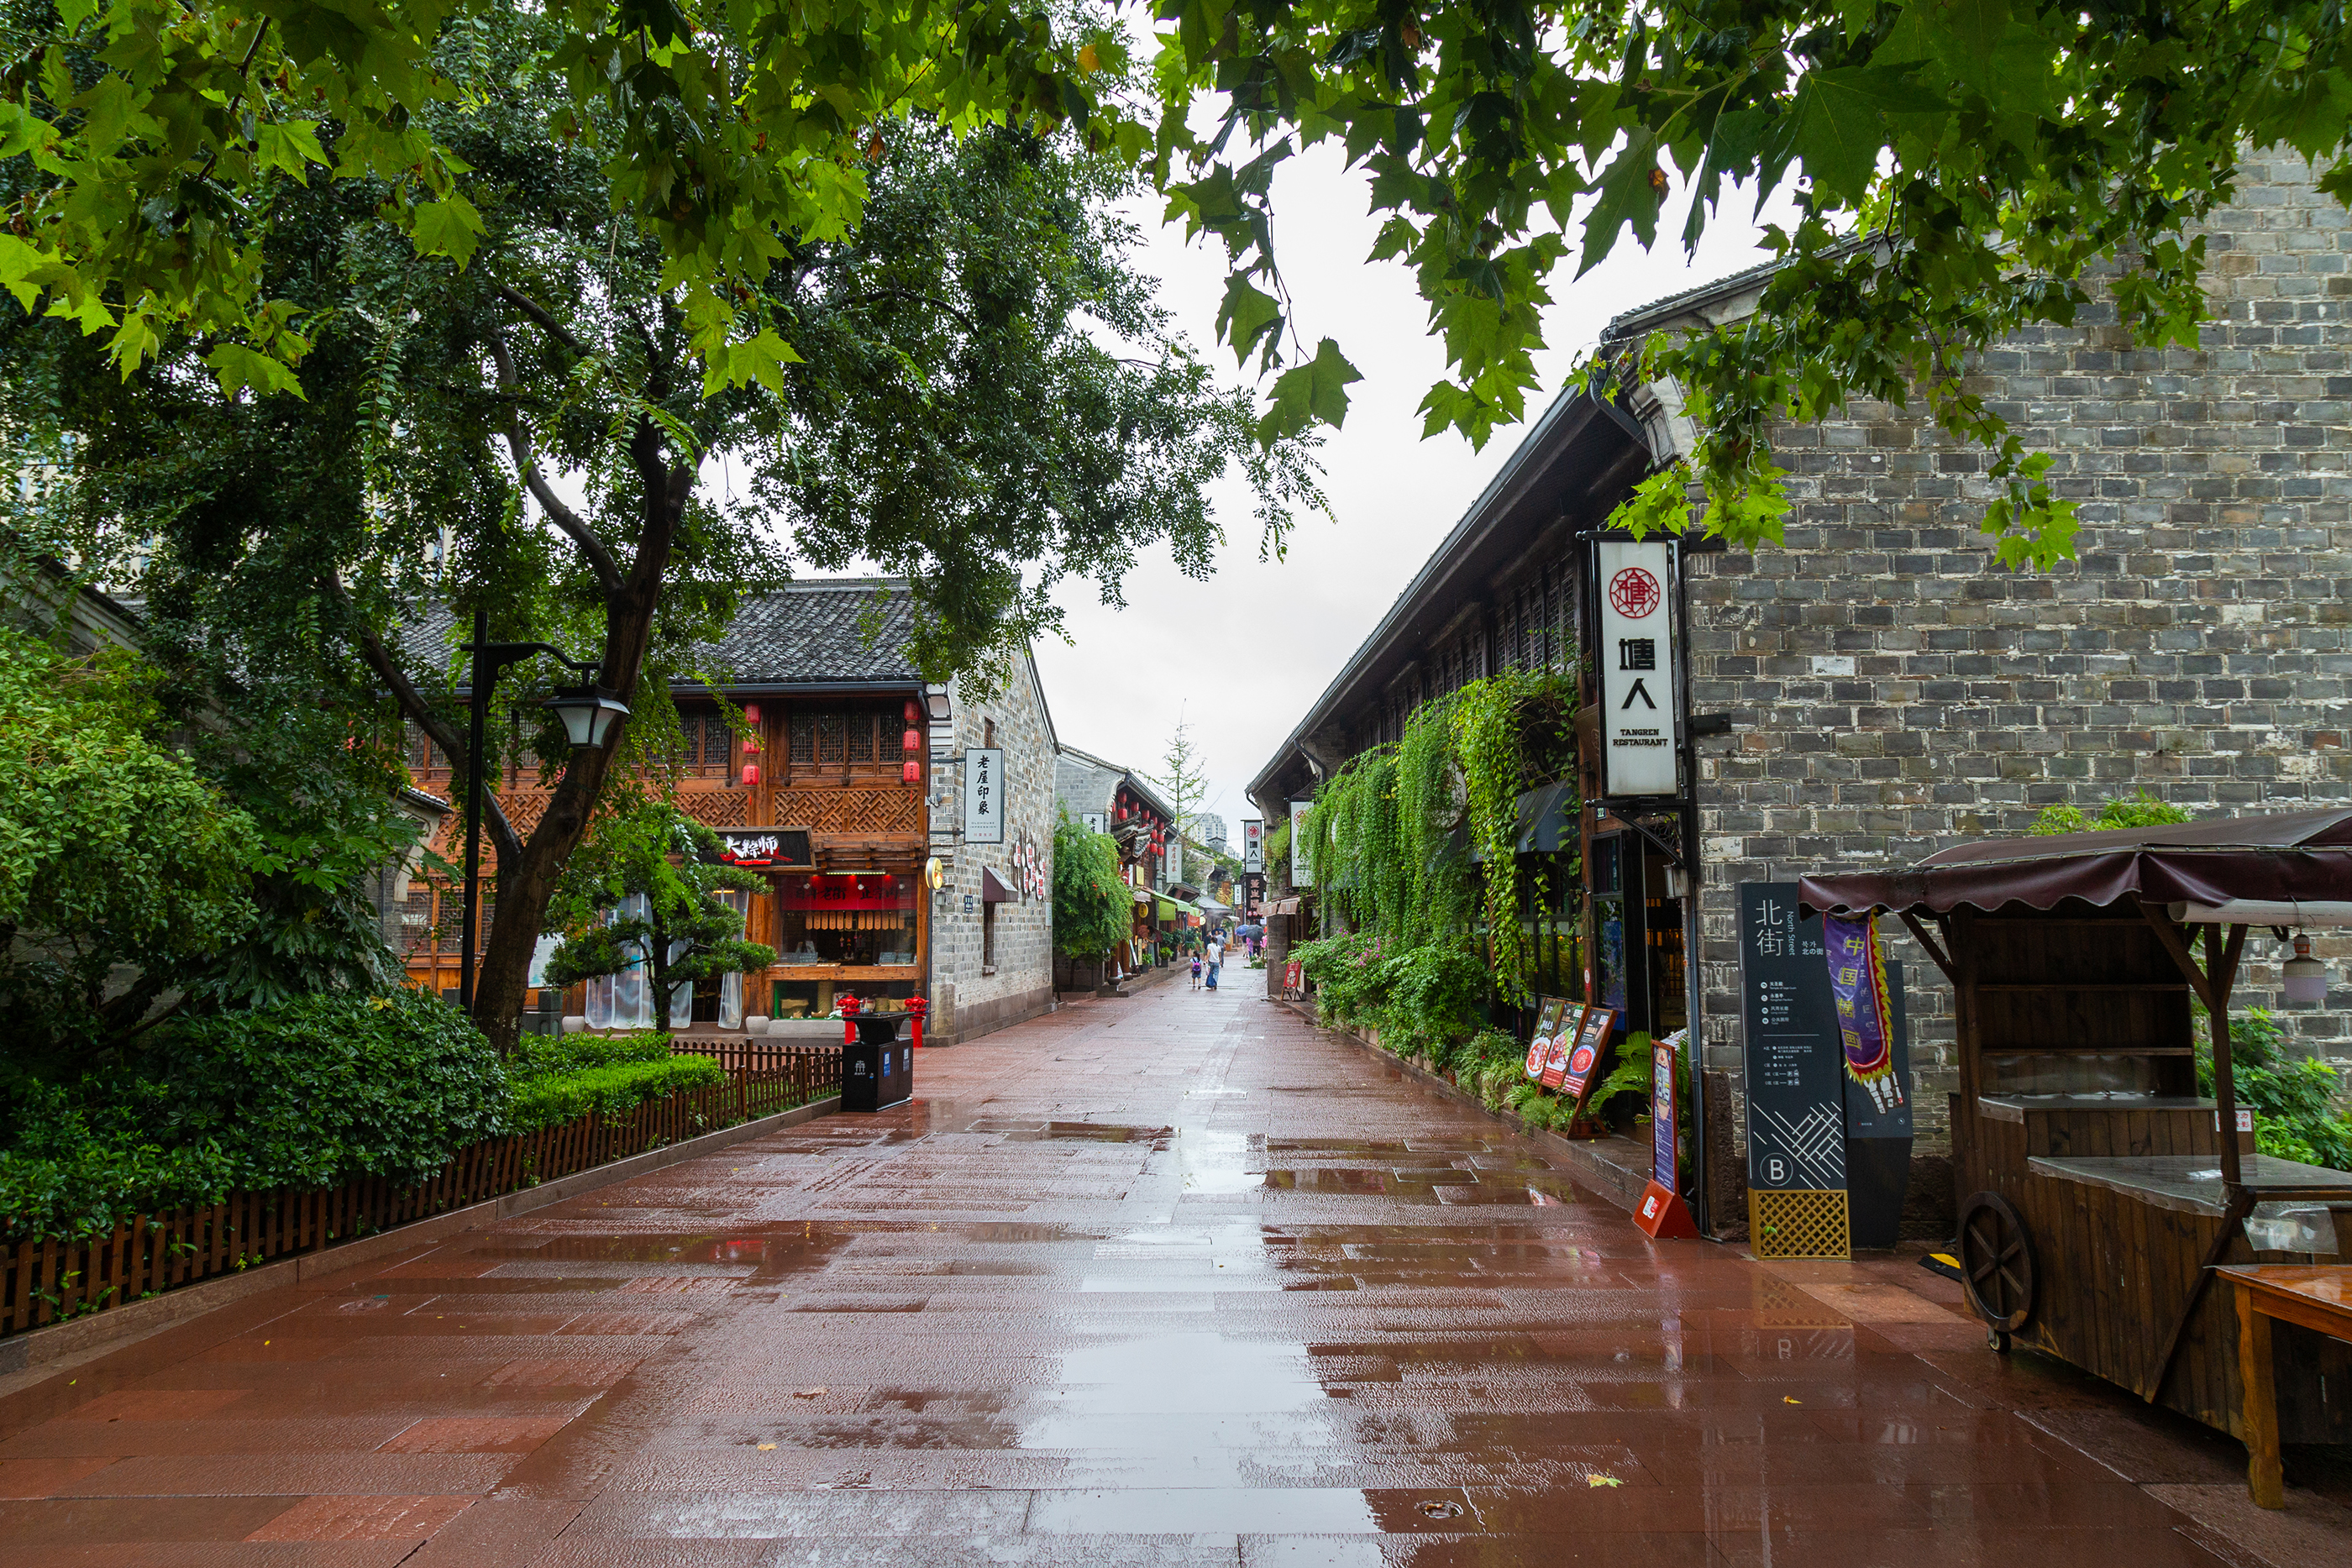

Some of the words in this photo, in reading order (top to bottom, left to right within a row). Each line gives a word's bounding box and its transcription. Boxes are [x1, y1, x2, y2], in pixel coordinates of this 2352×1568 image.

[1619, 638, 1657, 709] 塘人
[976, 755, 990, 815] 老屋印象
[725, 836, 779, 858] 大粽师
[1755, 899, 1783, 956] 北街
[1787, 911, 1795, 932] North
[1837, 936, 1865, 1050] 中国糖画
[1770, 1160, 1784, 1180] B
